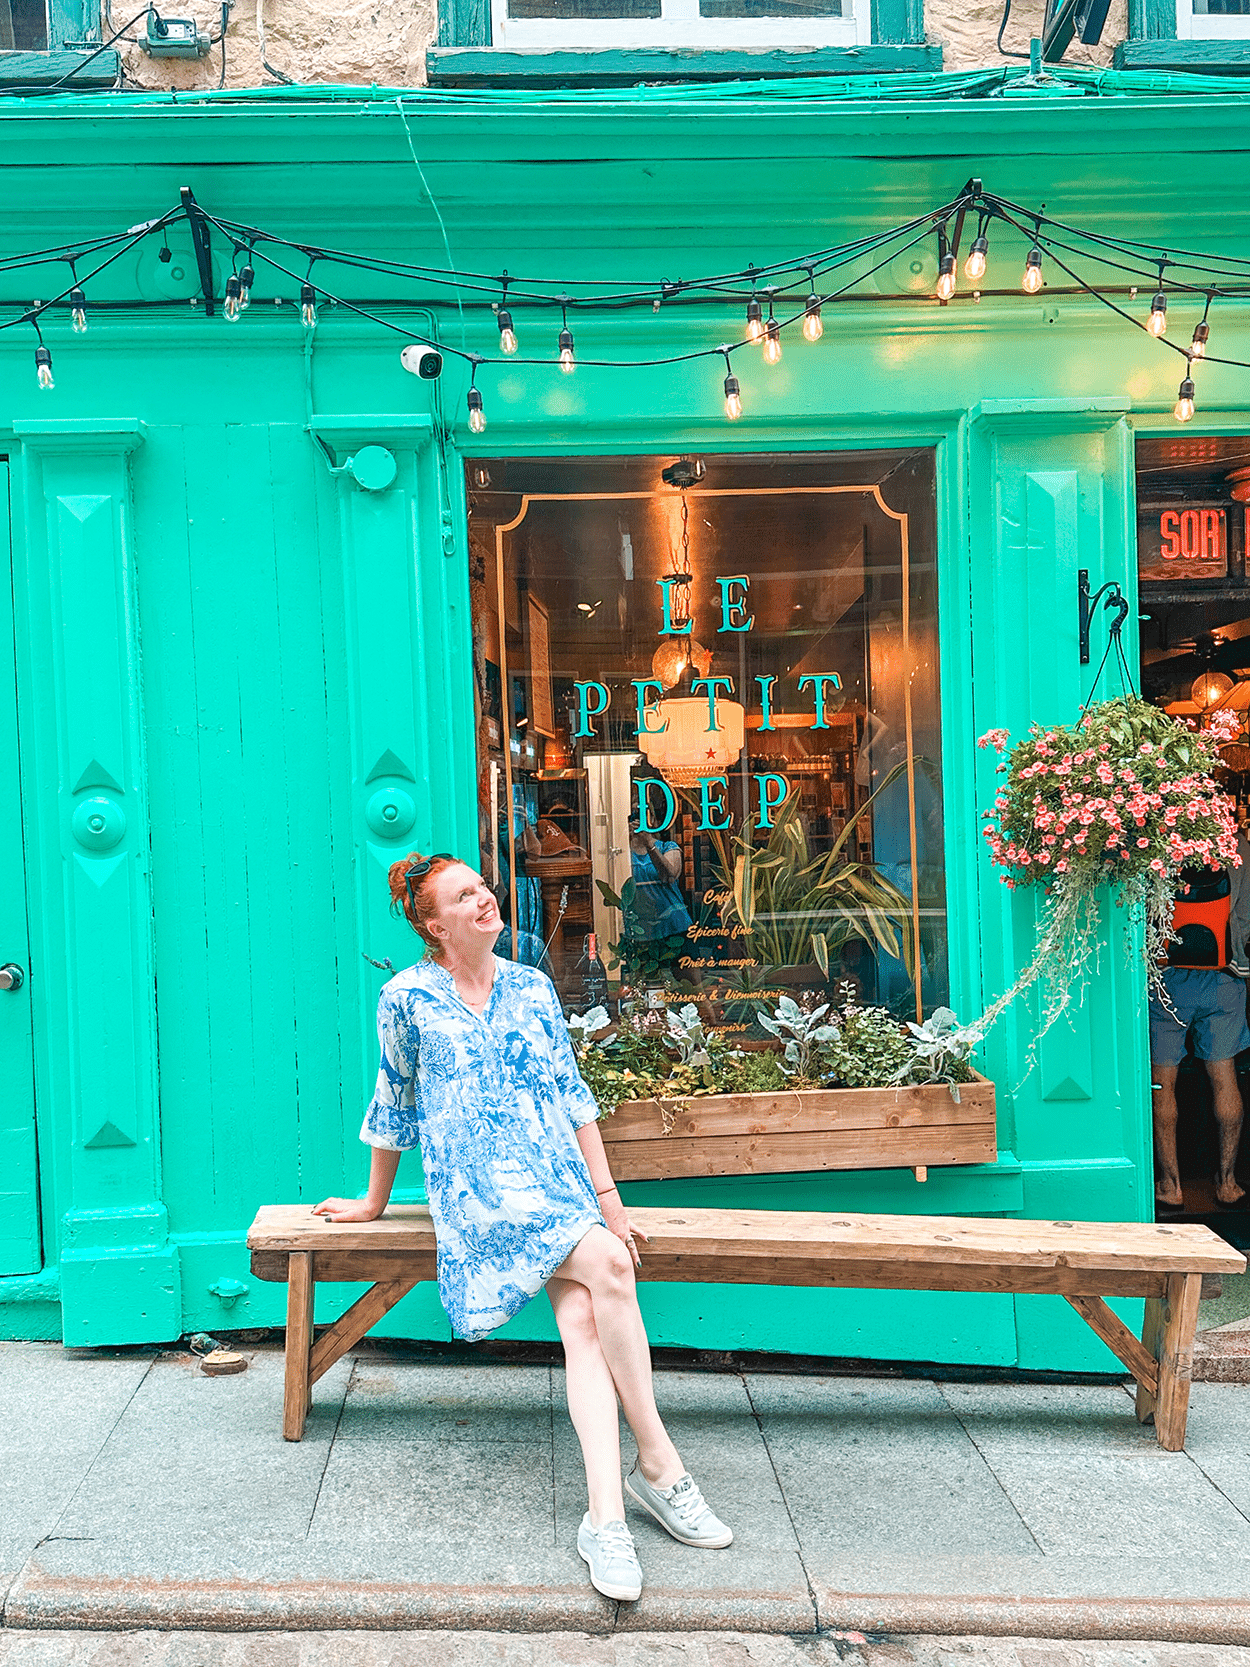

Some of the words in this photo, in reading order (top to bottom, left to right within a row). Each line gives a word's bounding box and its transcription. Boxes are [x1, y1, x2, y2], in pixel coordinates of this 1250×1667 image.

[1160, 509, 1225, 559] SOR
[656, 575, 755, 635] LE
[574, 671, 843, 738] PETIT
[633, 773, 791, 834] DEP
[686, 921, 730, 943] Épicerie
[731, 925, 755, 940] fine
[678, 956, 706, 969] Prêt
[706, 956, 718, 968] à
[718, 957, 760, 970] manger
[709, 990, 719, 1001] &
